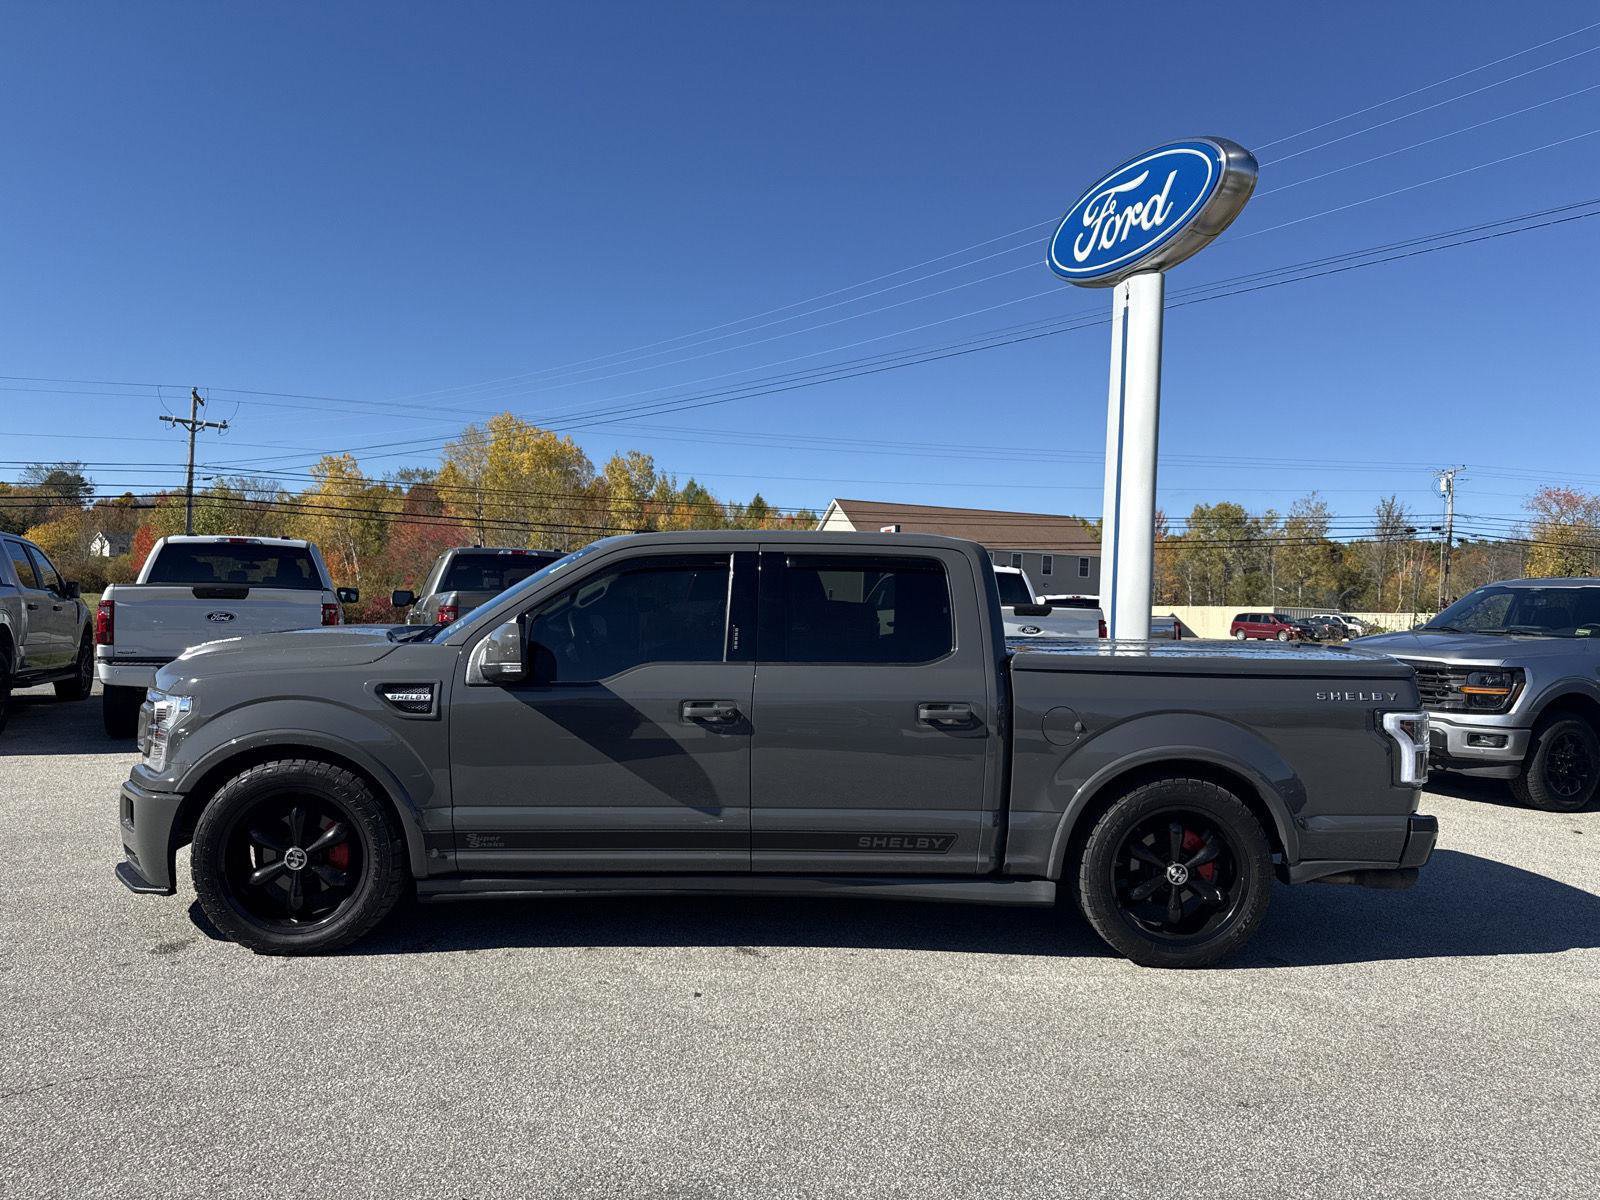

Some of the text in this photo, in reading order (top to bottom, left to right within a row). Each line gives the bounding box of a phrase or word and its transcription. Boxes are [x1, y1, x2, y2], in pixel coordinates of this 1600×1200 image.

[1073, 169, 1178, 263] Ford
[210, 613, 231, 621] Ford
[1316, 691, 1398, 701] SHELBY
[858, 836, 946, 849] SHELBY
